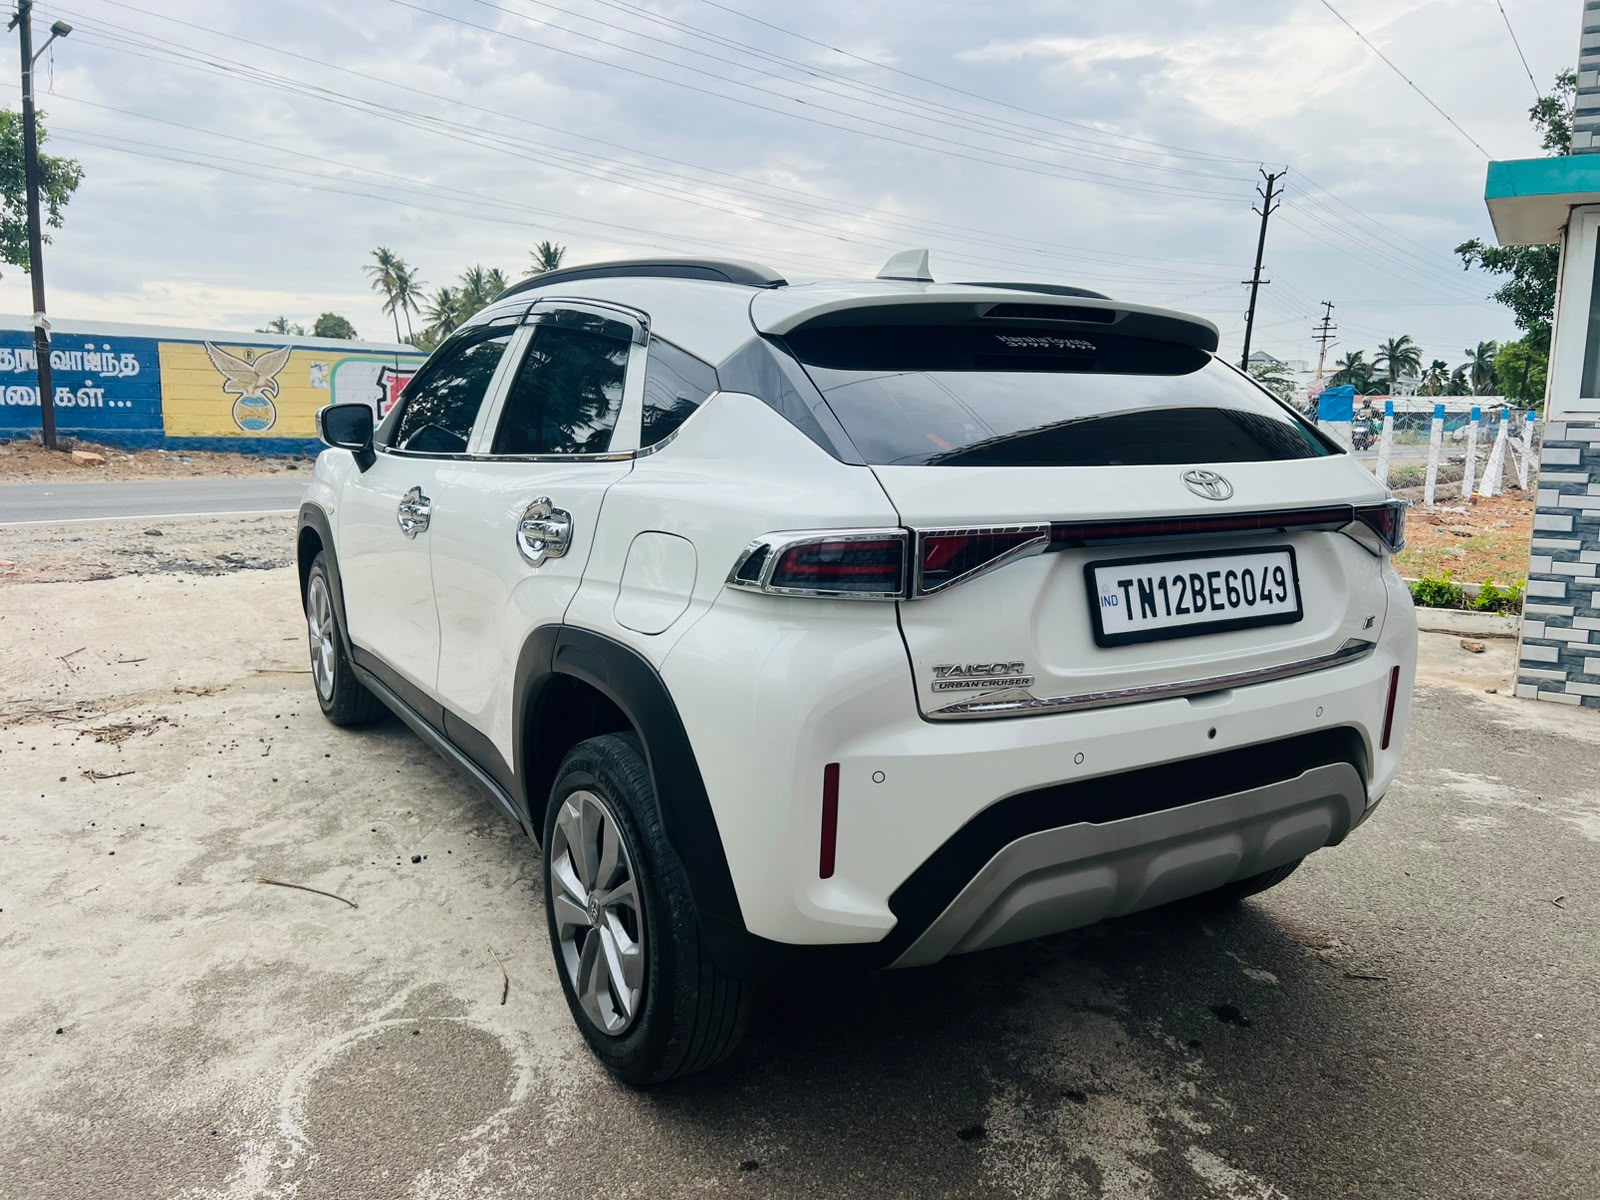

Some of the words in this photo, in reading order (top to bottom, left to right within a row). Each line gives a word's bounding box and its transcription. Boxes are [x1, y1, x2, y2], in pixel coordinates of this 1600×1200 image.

[1117, 565, 1288, 621] TN12BE6049
[1101, 595, 1118, 607] IND
[932, 661, 1025, 678] TAISOR
[939, 681, 979, 690] URBAN
[981, 678, 1030, 687] CRUISER
